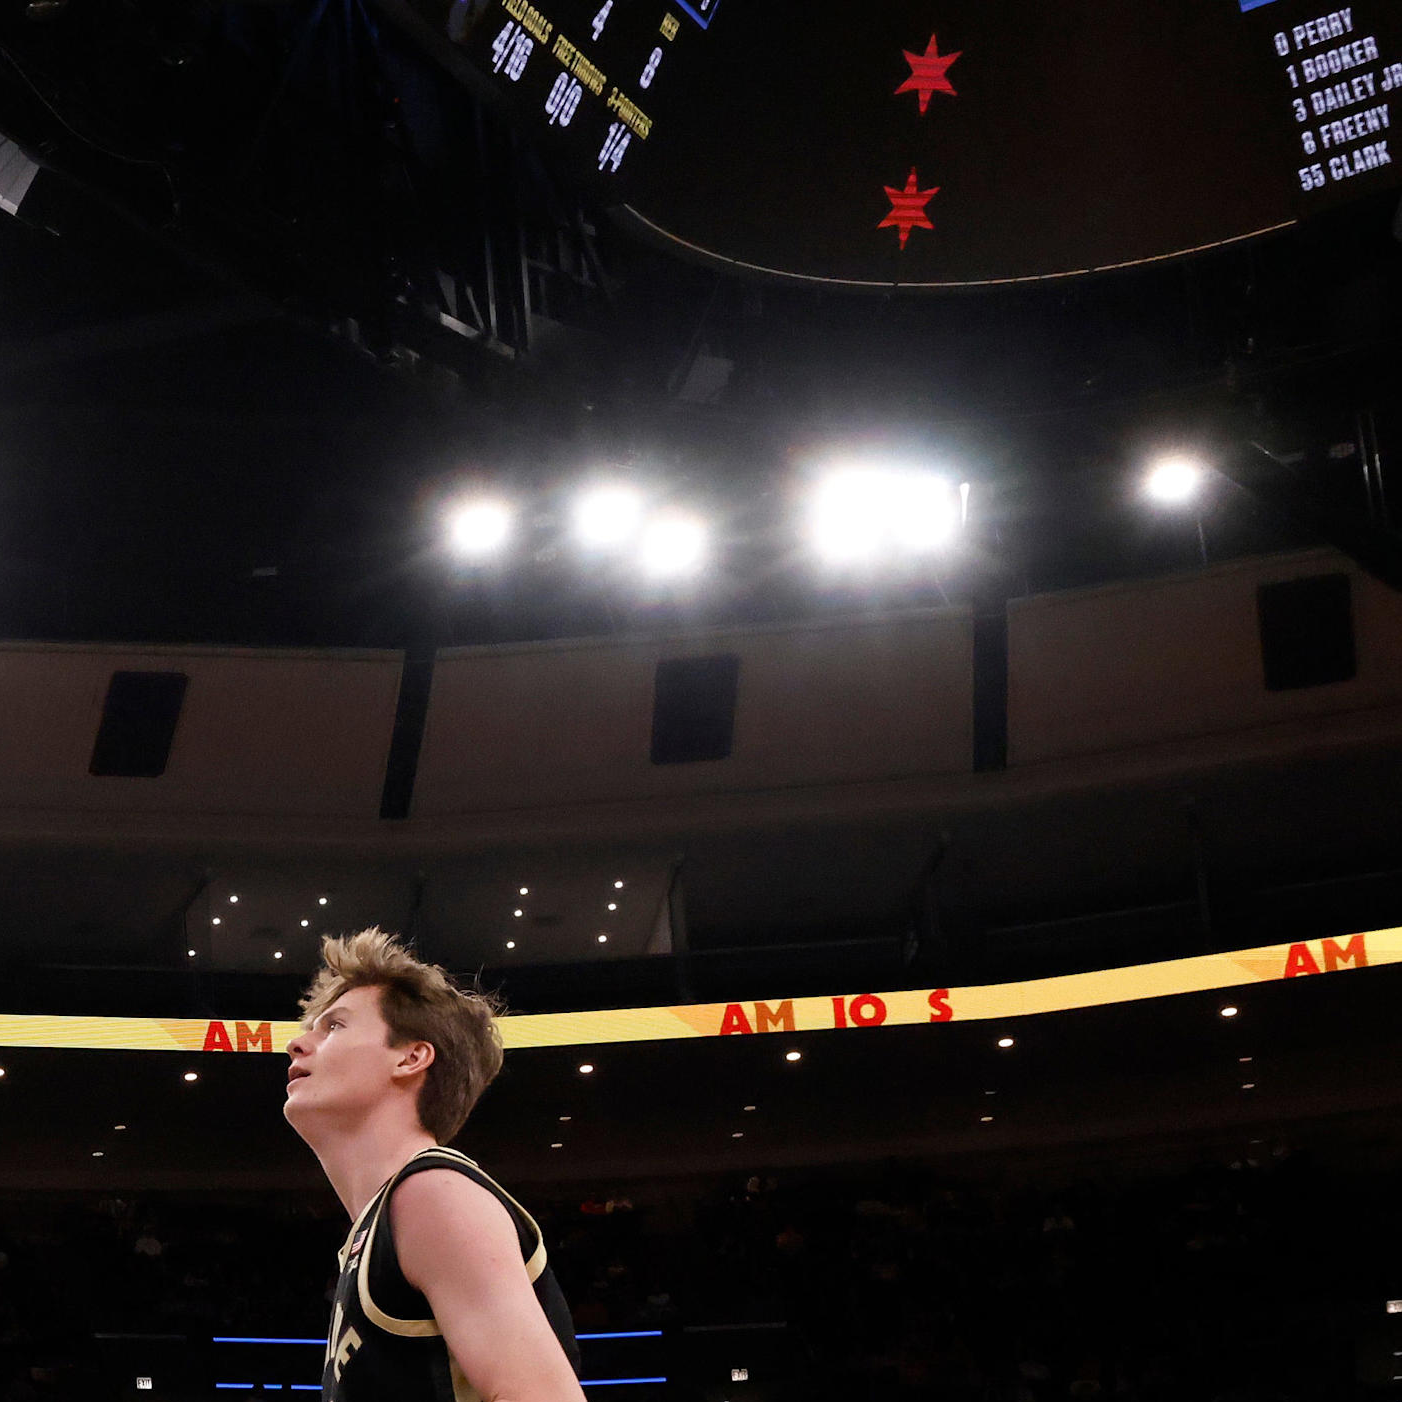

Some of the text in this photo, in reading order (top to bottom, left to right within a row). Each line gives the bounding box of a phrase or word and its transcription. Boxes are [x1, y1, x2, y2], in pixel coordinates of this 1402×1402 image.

[492, 21, 534, 81] 4/16
[1274, 7, 1353, 56] 0 PERRY
[640, 47, 662, 88] 8
[1286, 36, 1379, 88] 1 BOOKER
[545, 72, 582, 127] 0/0
[1293, 98, 1307, 122] 3
[1310, 72, 1376, 116] DAILEY
[598, 122, 632, 172] 1/4
[1301, 104, 1390, 155] 8 FREENY
[1298, 140, 1392, 191] 55 CLARK
[1278, 935, 1369, 980] AM
[204, 1022, 273, 1053] AM
[720, 990, 955, 1037] AM IO S
